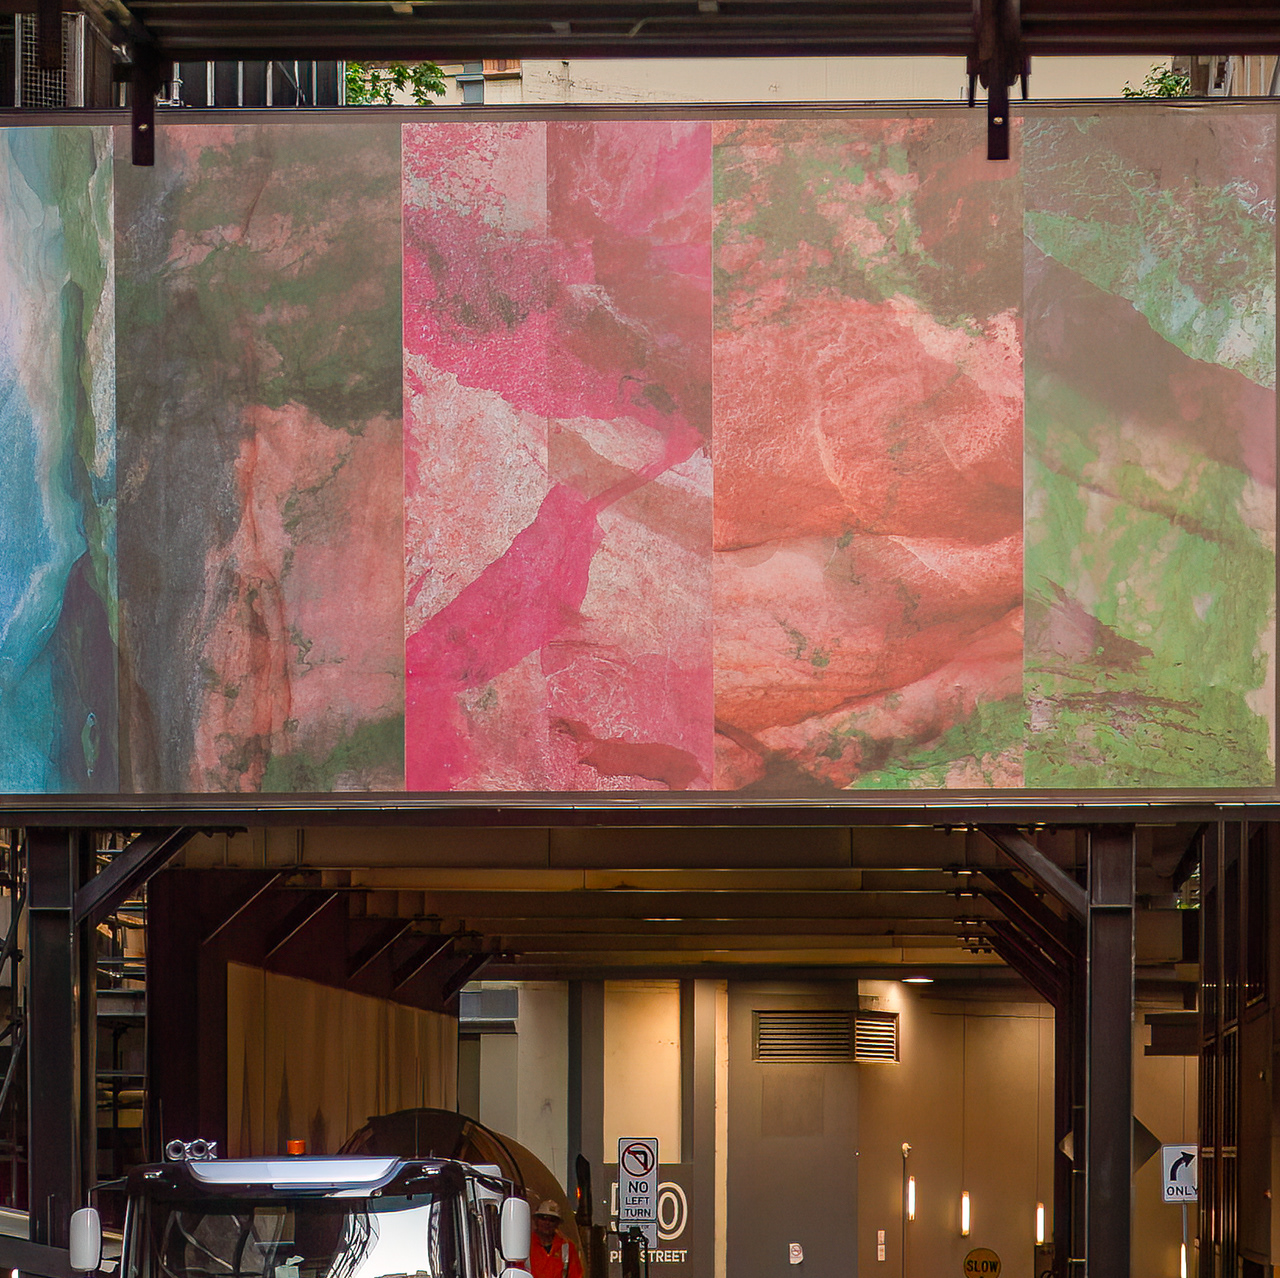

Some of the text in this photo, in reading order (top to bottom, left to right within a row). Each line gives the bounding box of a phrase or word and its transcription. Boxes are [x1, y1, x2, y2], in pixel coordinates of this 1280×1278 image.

[628, 1182, 648, 1193] NO
[1166, 1185, 1199, 1196] ONLY
[625, 1196, 650, 1206] LEFT
[624, 1209, 651, 1217] TURN
[966, 1260, 999, 1273] SLOW
